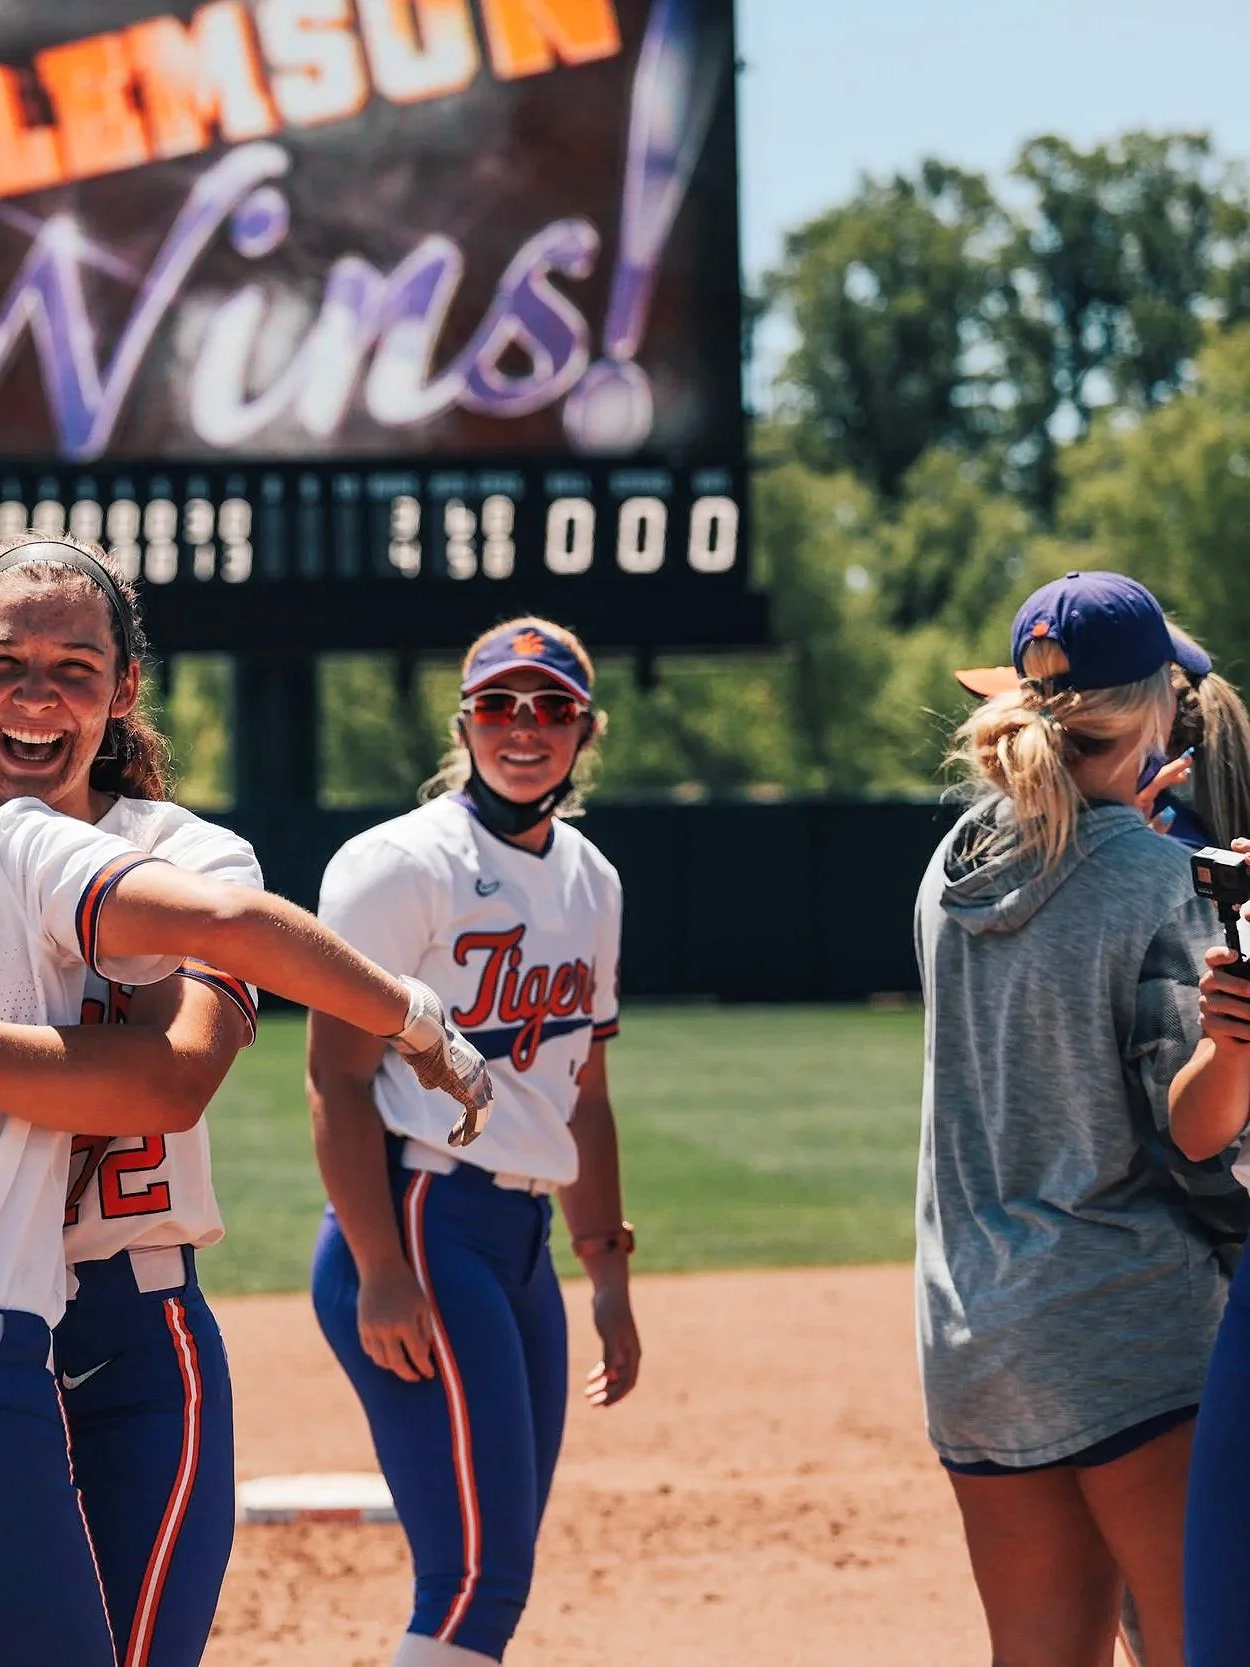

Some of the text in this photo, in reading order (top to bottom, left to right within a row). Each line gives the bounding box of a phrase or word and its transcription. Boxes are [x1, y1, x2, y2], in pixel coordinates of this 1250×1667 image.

[545, 496, 740, 574] 0 0 0
[451, 922, 596, 1072] Tiger
